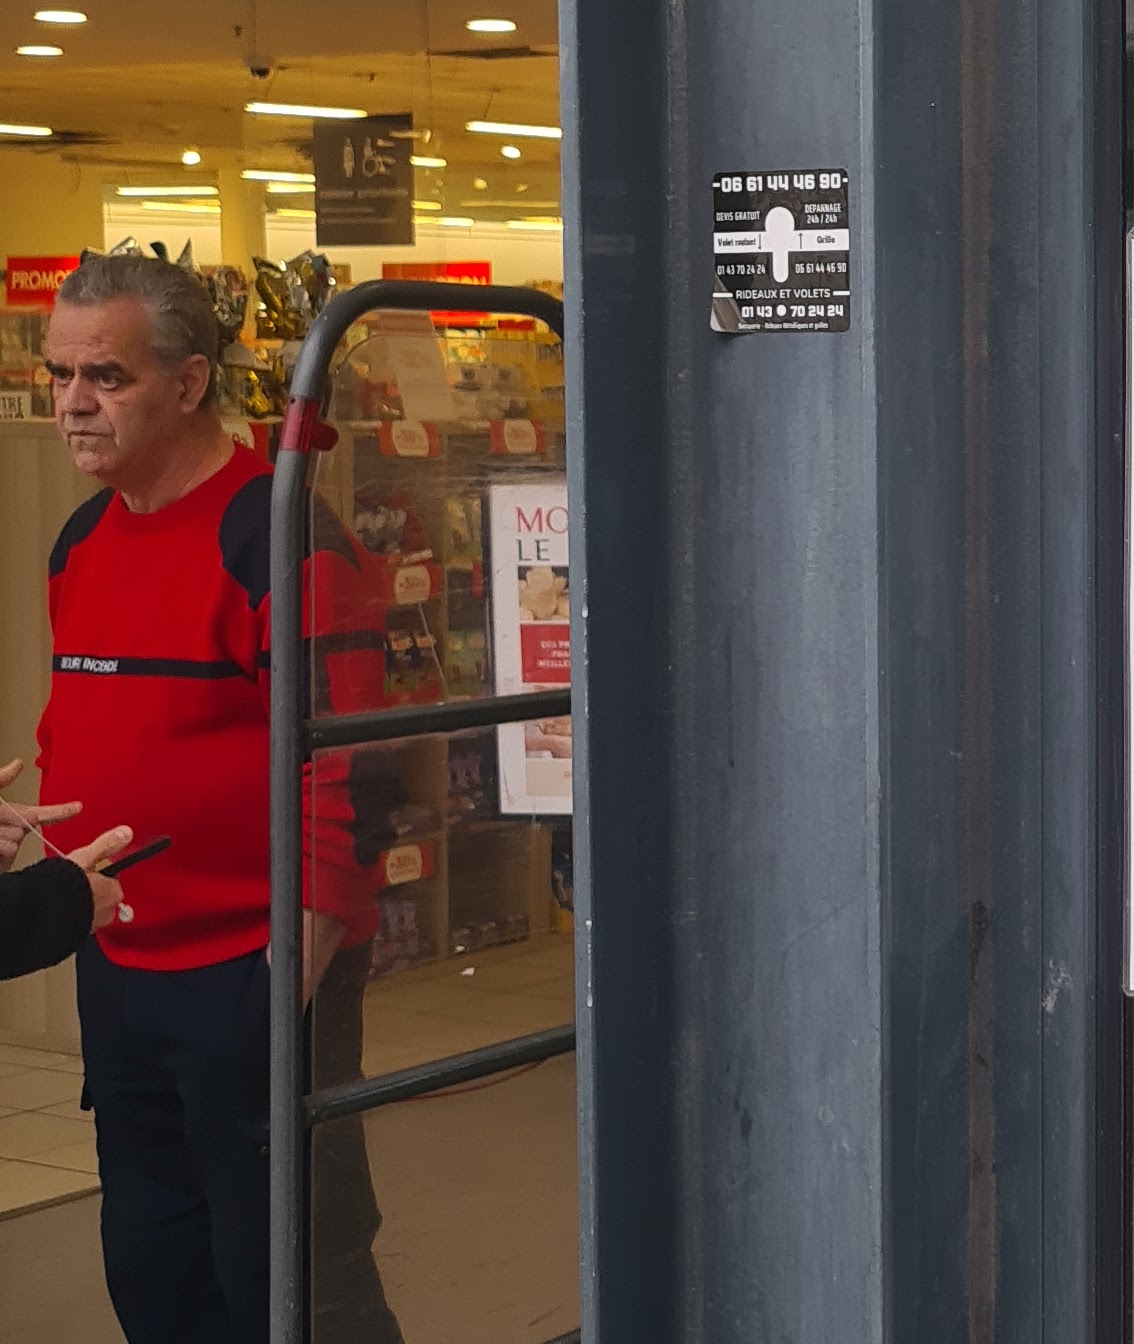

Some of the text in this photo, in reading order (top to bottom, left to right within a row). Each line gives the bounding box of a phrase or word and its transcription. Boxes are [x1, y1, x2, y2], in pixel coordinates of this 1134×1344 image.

[722, 173, 841, 192] 06 61 44 46 90
[807, 214, 819, 224] 24h
[825, 214, 837, 223] 24h
[717, 264, 765, 274] 01 43 70 24 24
[795, 263, 847, 273] 06 61 44 46 90
[736, 288, 831, 299] RIDEAUX ET VOLETS
[742, 305, 843, 318] 01 43 70 24 24
[516, 539, 550, 561] LE
